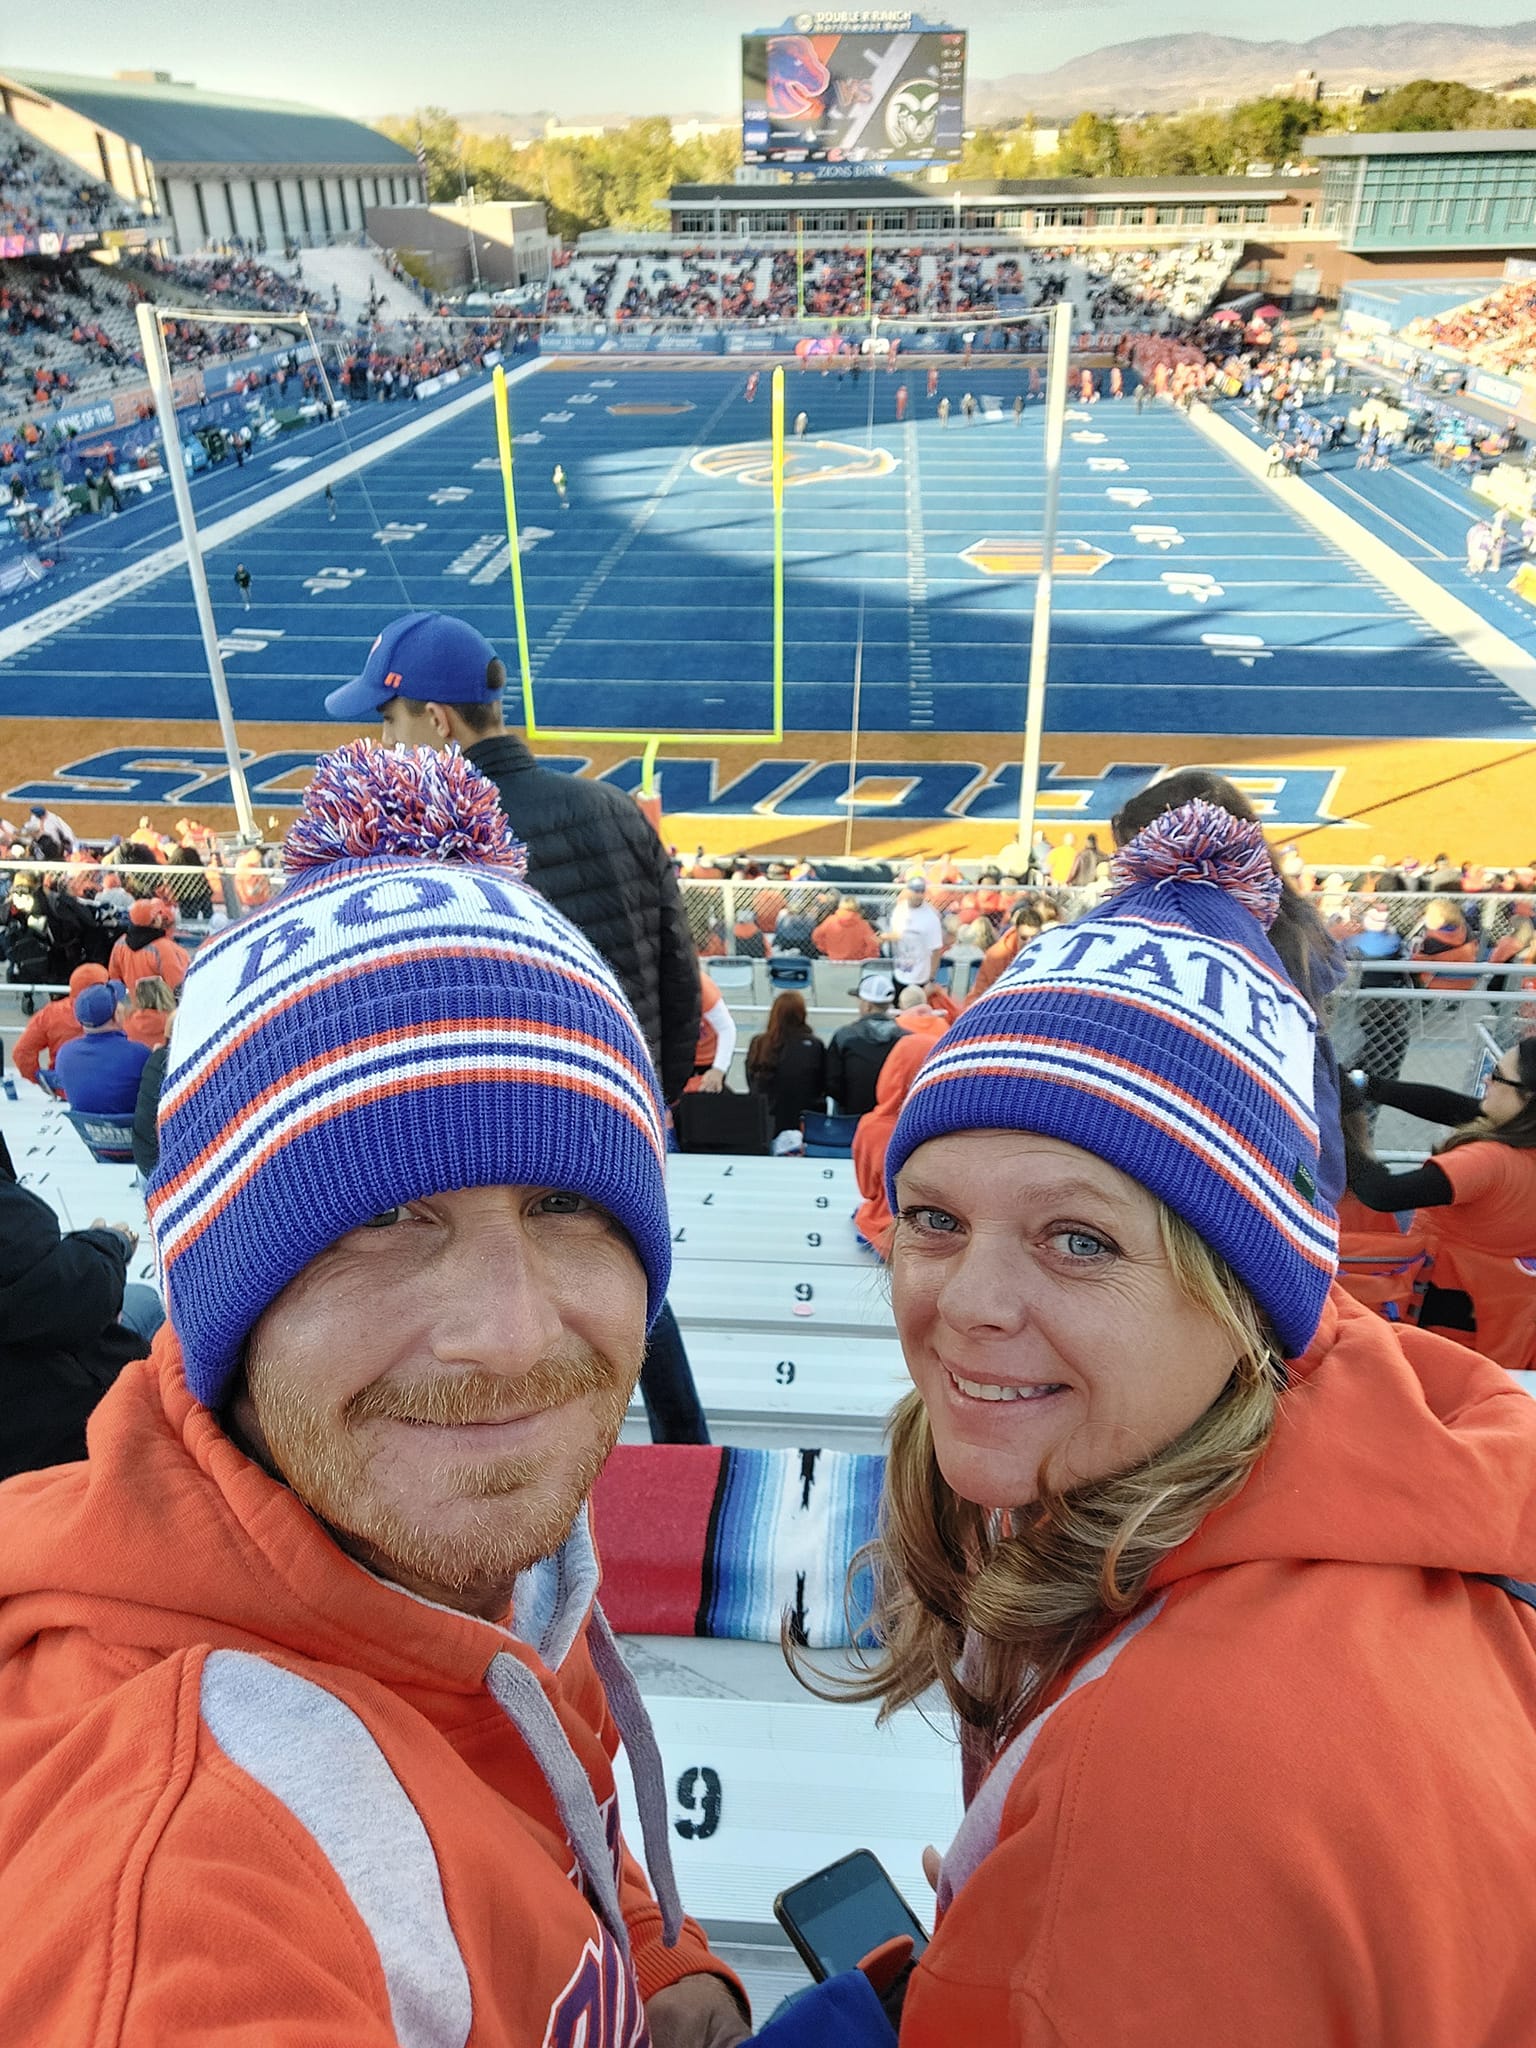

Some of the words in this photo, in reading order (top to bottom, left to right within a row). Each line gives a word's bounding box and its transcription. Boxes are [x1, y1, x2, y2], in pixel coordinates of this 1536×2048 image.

[816, 11, 861, 22] DOUBLE
[871, 10, 912, 22] RANCH
[816, 166, 852, 178] ZIONS
